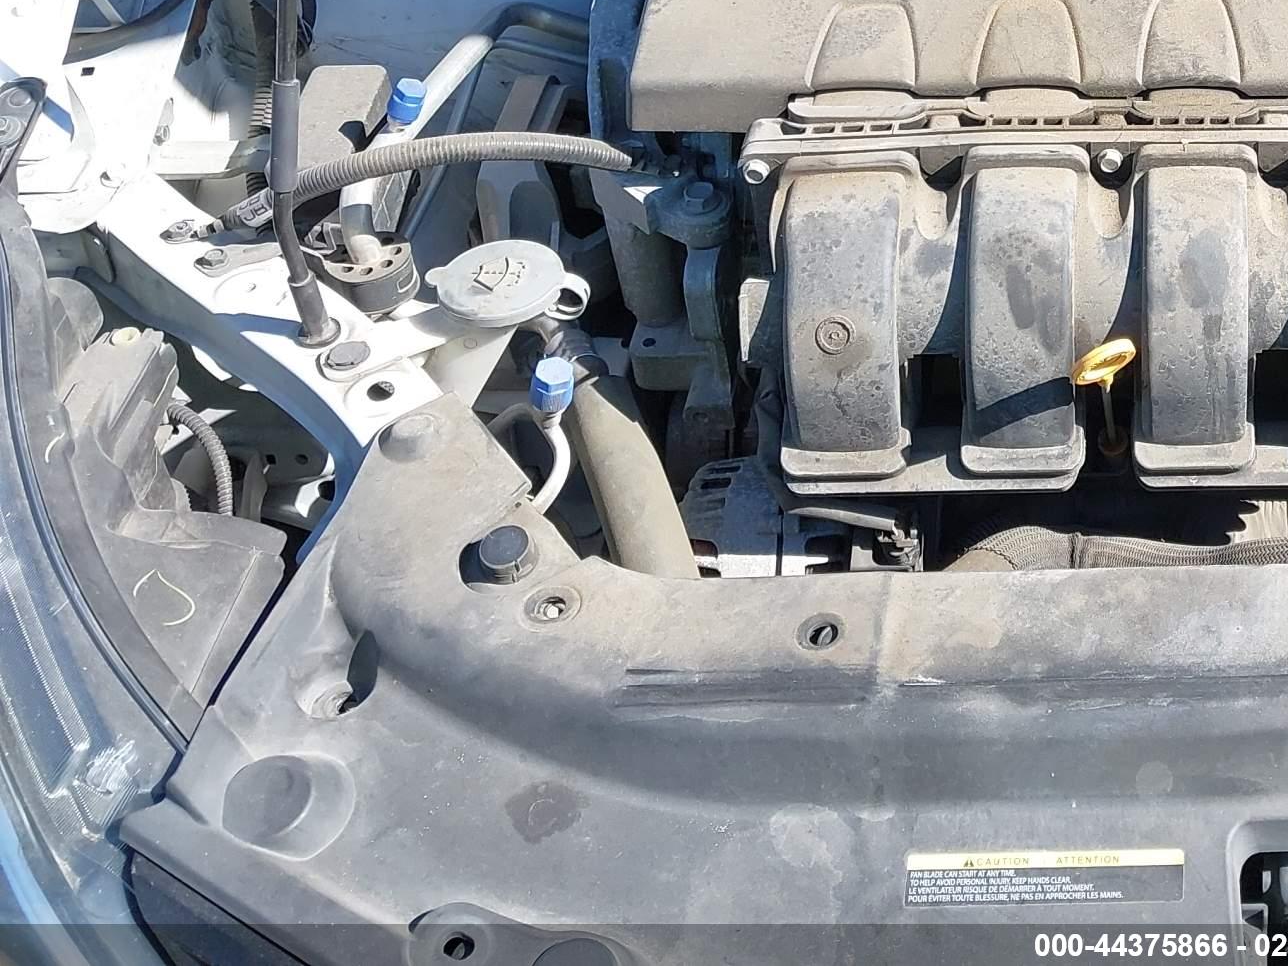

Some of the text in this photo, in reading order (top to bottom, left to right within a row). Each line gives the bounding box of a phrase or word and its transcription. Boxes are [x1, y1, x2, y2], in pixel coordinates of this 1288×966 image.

[976, 855, 1120, 866] CAUTION ATTENTION
[944, 870, 958, 878] CAN
[958, 870, 978, 878] START
[936, 878, 956, 886] AVOID
[1011, 877, 1027, 885] KEEP
[909, 887, 917, 895] LE
[917, 886, 962, 895] VENTILATEUR
[962, 885, 987, 894] RISQUE
[988, 885, 998, 893] DE
[1043, 884, 1061, 892] TOUT
[908, 895, 927, 903] POUR
[951, 894, 974, 902] TOUTE
[1010, 893, 1021, 901] NE
[1021, 892, 1034, 900] PAS
[1034, 892, 1045, 900] EN
[1045, 891, 1086, 900] APPROCHER
[1086, 891, 1099, 899] LES
